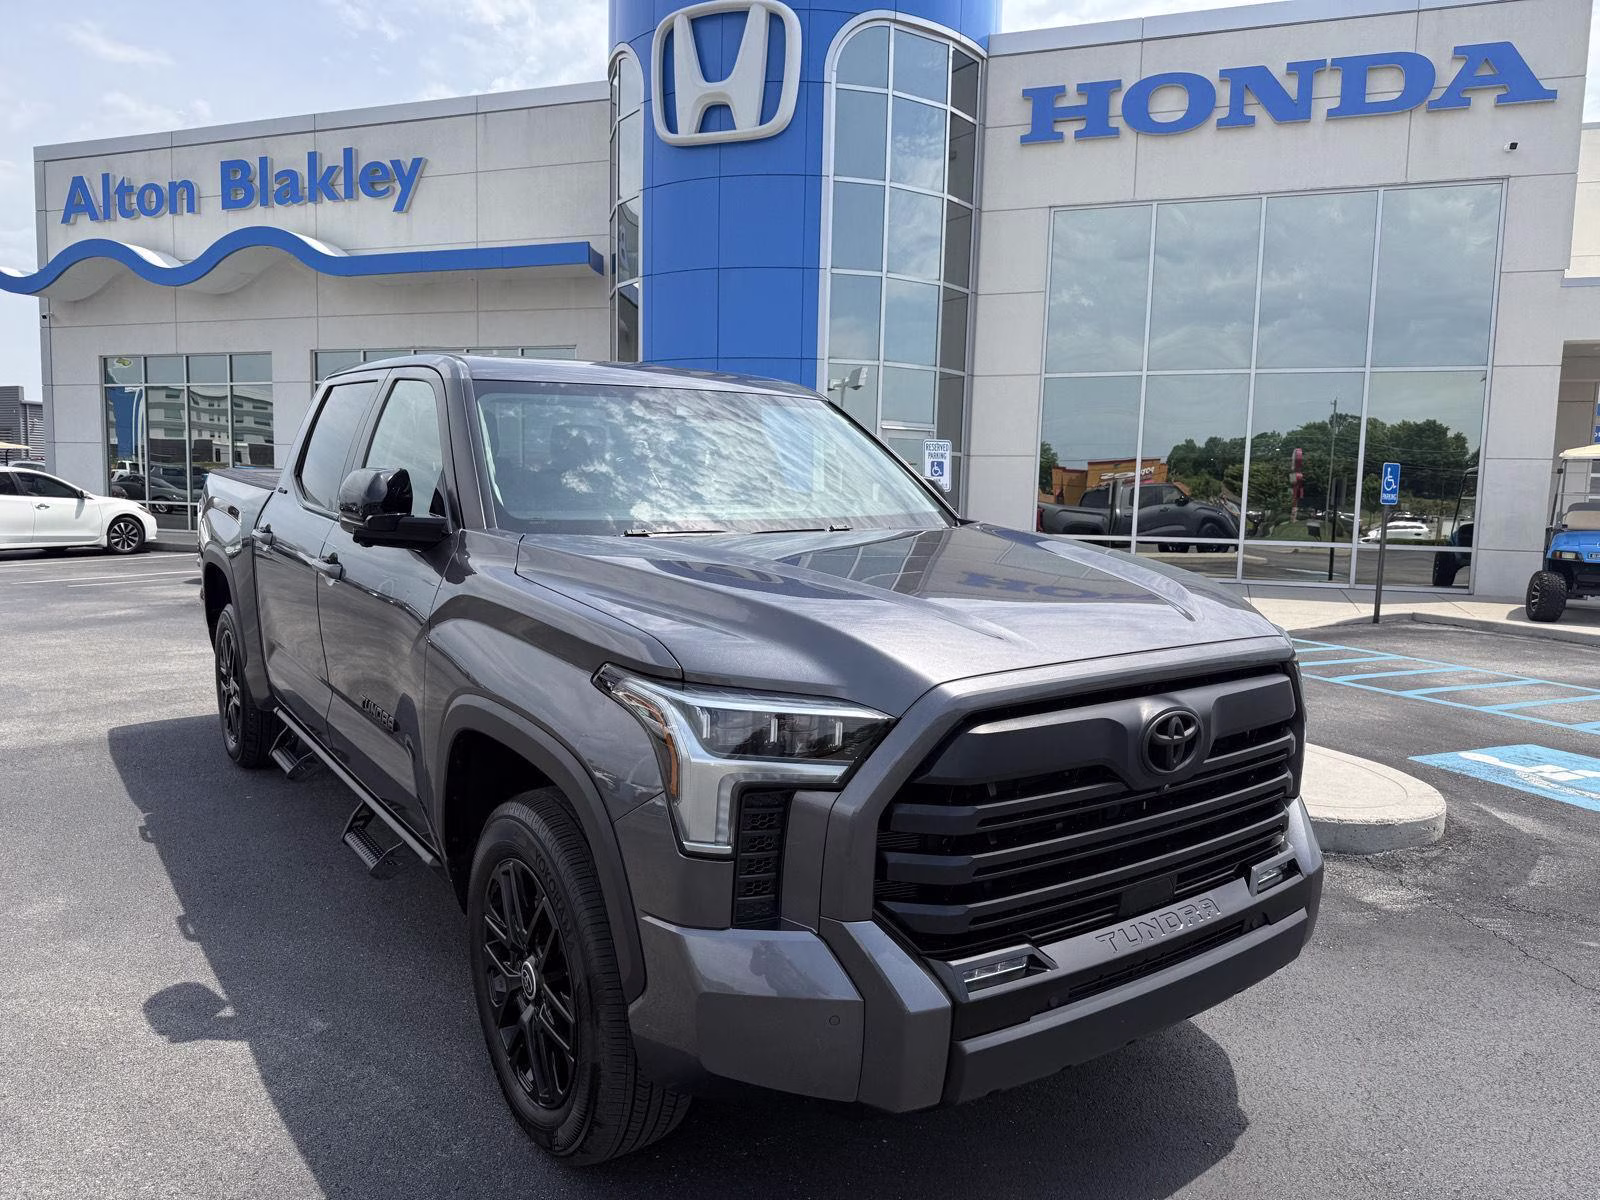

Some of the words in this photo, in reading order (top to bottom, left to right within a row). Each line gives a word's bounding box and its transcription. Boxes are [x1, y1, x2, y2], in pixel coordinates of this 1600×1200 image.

[1020, 41, 1558, 144] HONDA
[61, 172, 198, 225] Alton
[220, 147, 425, 212] Blakley
[925, 443, 949, 452] RESERVED
[927, 452, 947, 460] PARKING
[1095, 897, 1222, 954] TUNDRA
